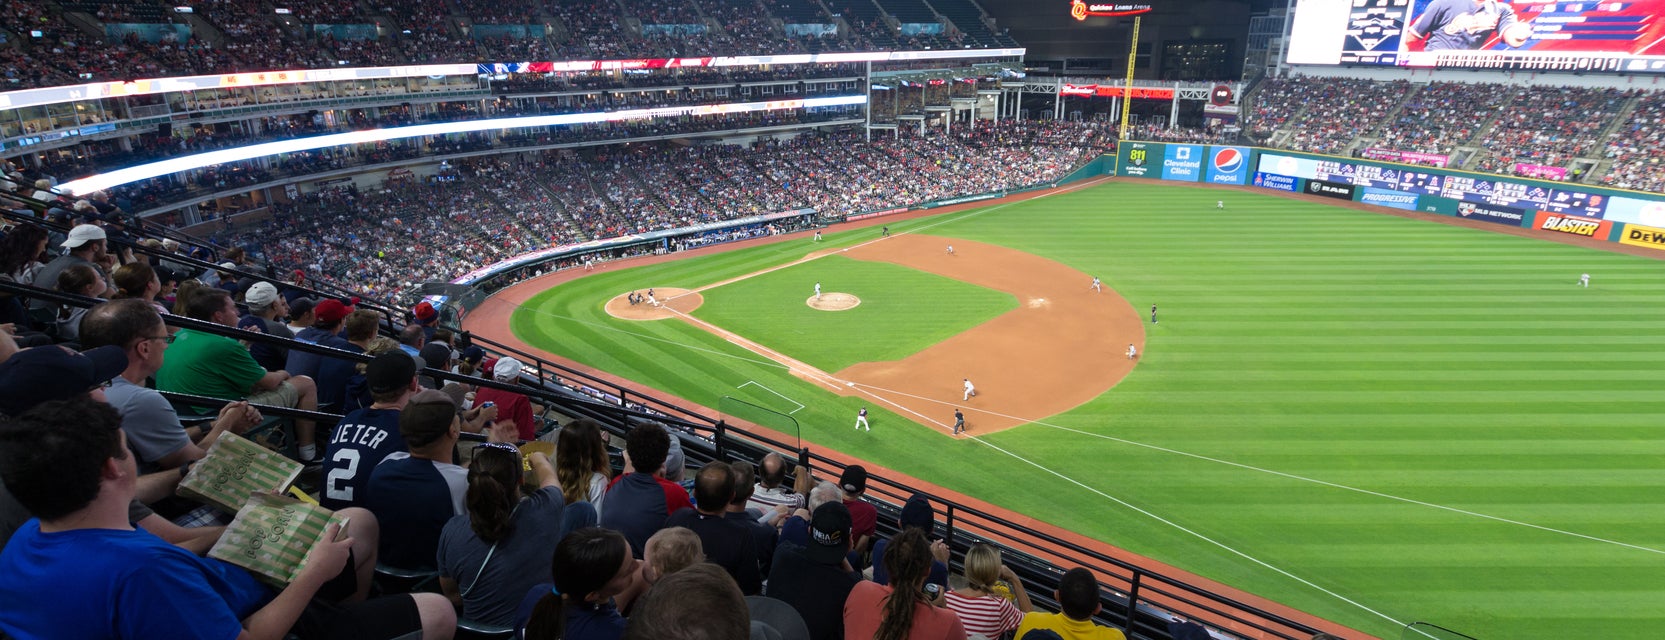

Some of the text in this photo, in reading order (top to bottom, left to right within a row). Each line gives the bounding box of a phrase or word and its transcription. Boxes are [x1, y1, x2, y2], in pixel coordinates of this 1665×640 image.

[1071, 2, 1087, 20] Q
[1130, 149, 1146, 160] 811
[1164, 160, 1200, 168] Cleveland
[1170, 167, 1191, 175] Clinic
[1213, 174, 1237, 182] pepsi
[1265, 173, 1294, 184] SHERWIN
[1322, 185, 1349, 195] RAM
[1362, 193, 1419, 204] PROGRESSIVE
[1489, 210, 1523, 220] NETWORK
[1541, 216, 1601, 237] BLASTER
[331, 424, 388, 449] JETER
[232, 450, 256, 480] CORN
[213, 464, 234, 492] POP
[327, 448, 360, 501] 2
[267, 507, 296, 543] CORN
[245, 527, 266, 559] POP
